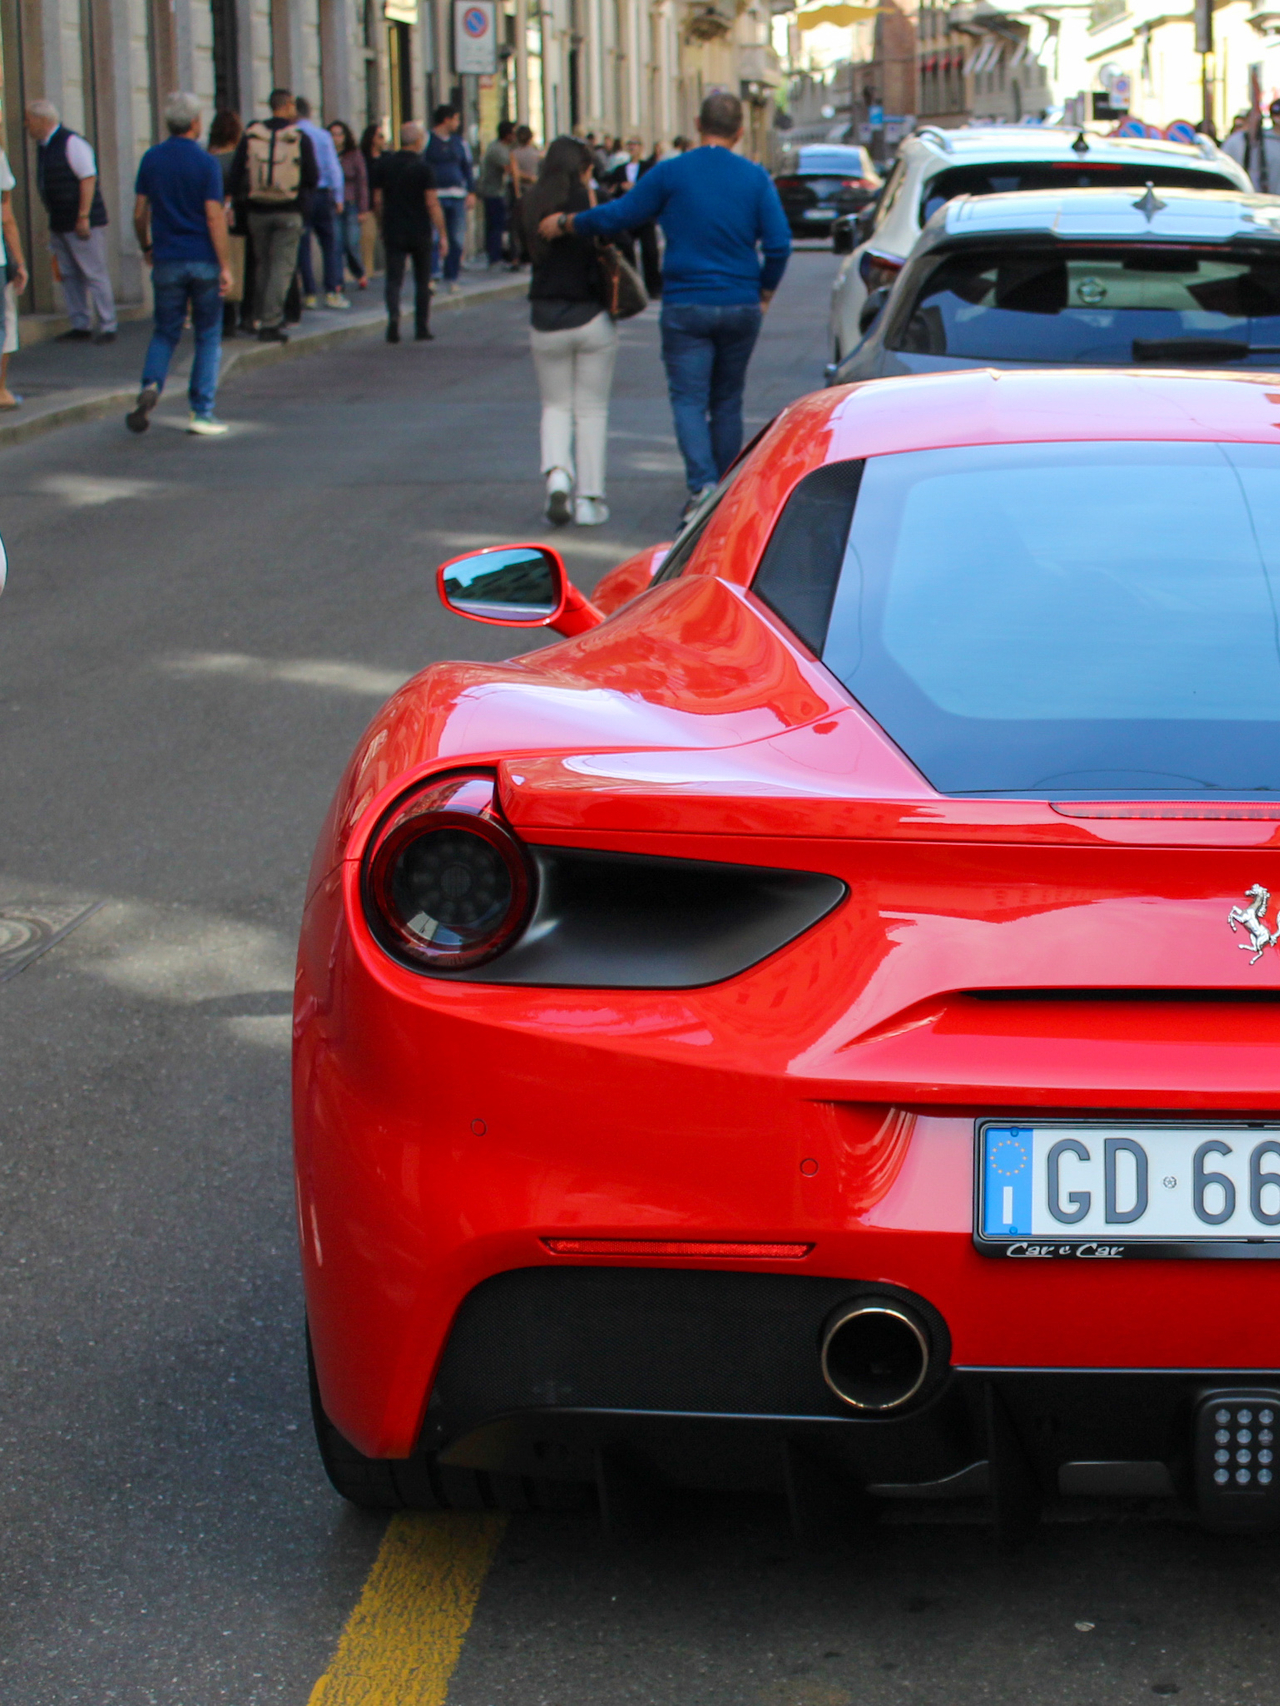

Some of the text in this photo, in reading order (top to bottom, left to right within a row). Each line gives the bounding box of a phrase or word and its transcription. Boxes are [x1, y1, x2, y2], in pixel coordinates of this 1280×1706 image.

[1046, 1137, 1149, 1226] GD
[1003, 1186, 1013, 1225] I
[1006, 1242, 1055, 1258] Car
[1076, 1242, 1125, 1259] Car
